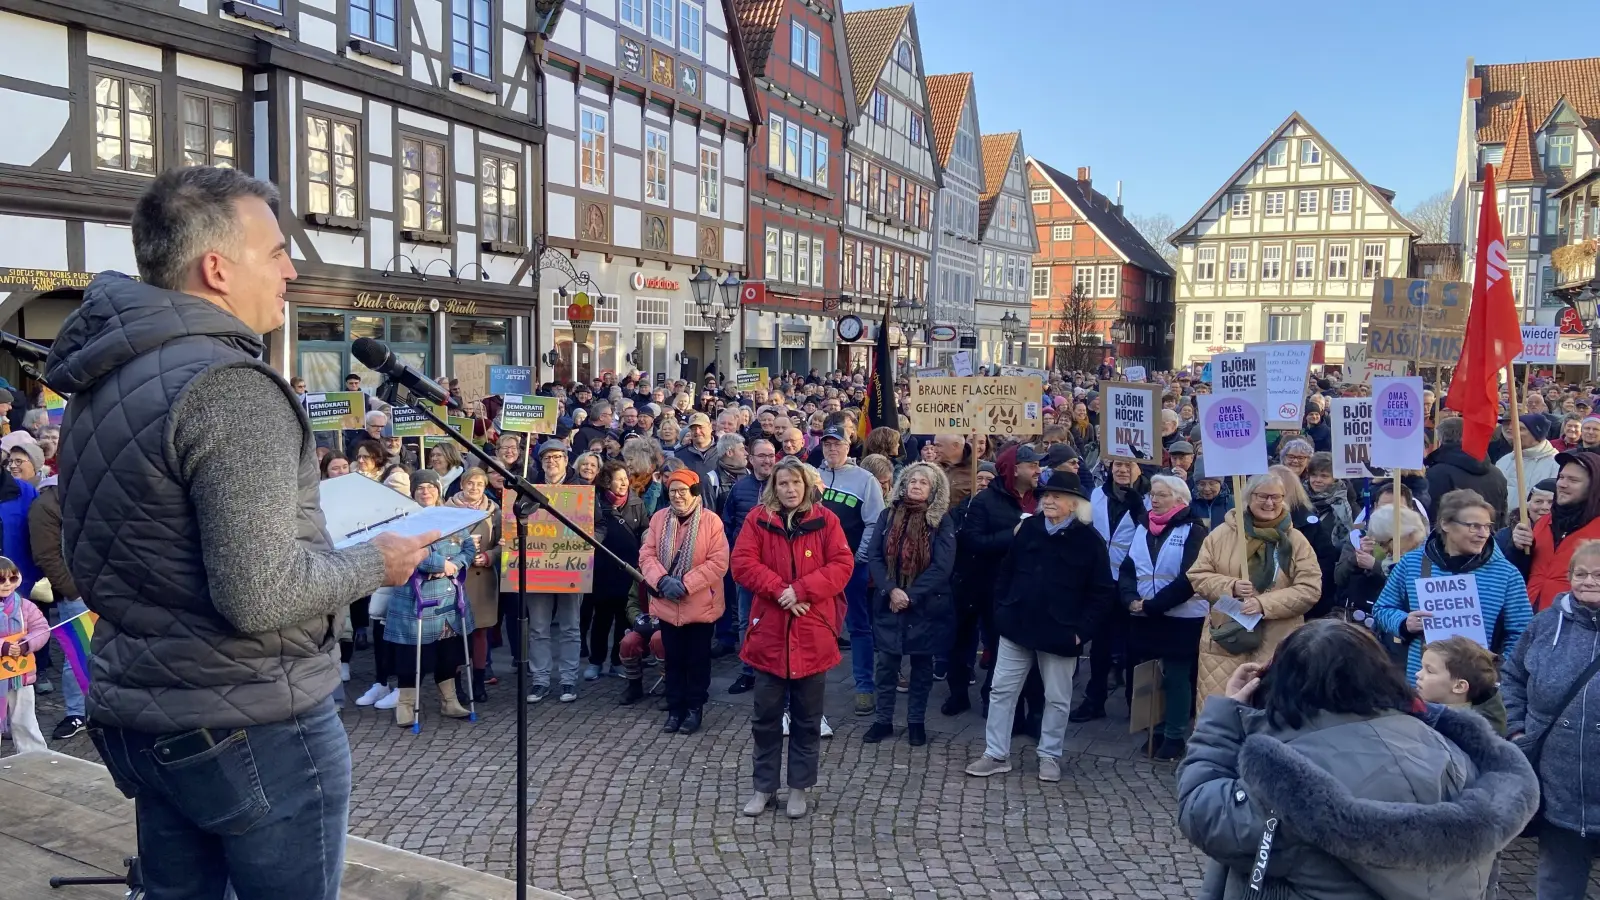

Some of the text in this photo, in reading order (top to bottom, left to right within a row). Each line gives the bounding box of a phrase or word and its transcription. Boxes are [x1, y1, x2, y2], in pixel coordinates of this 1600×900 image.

[9, 268, 16, 276] SI
[16, 269, 35, 277] DEUS
[36, 270, 49, 278] PRO
[50, 270, 71, 279] NOBIS
[1522, 327, 1559, 340] wieder
[1221, 356, 1256, 373] BJÖRN
[1221, 372, 1257, 389] HÖCKE
[918, 384, 1017, 396] BRAUNE FLASCHEN
[1388, 391, 1408, 401] OMAS
[310, 400, 350, 410] DEMOKRATIE
[1115, 392, 1144, 408] BJÖRN
[1387, 400, 1409, 410] GEGEN
[915, 401, 964, 413] GEHÖREN
[1219, 405, 1242, 415] OMAS
[1343, 402, 1372, 419] BJÖ
[1382, 409, 1414, 418] RECHTS
[395, 415, 415, 423] MEINT
[1115, 406, 1144, 422] HÖCKE
[1218, 413, 1245, 423] GEGEN
[934, 418, 970, 428] IN DEN
[1213, 420, 1252, 431] RECHTS
[1343, 418, 1372, 436] HÖC
[1383, 417, 1412, 427] RINTELN
[1115, 426, 1145, 447] NAZI
[1216, 429, 1250, 438] RINTELN
[1344, 443, 1372, 464] NA
[509, 538, 547, 551] Baun
[544, 560, 560, 569] ins
[565, 556, 588, 570] Klo
[1424, 578, 1467, 593] OMAS
[1424, 596, 1475, 612] GEGEN
[1422, 614, 1482, 630] RECHTS
[1257, 831, 1272, 869] LOVE
